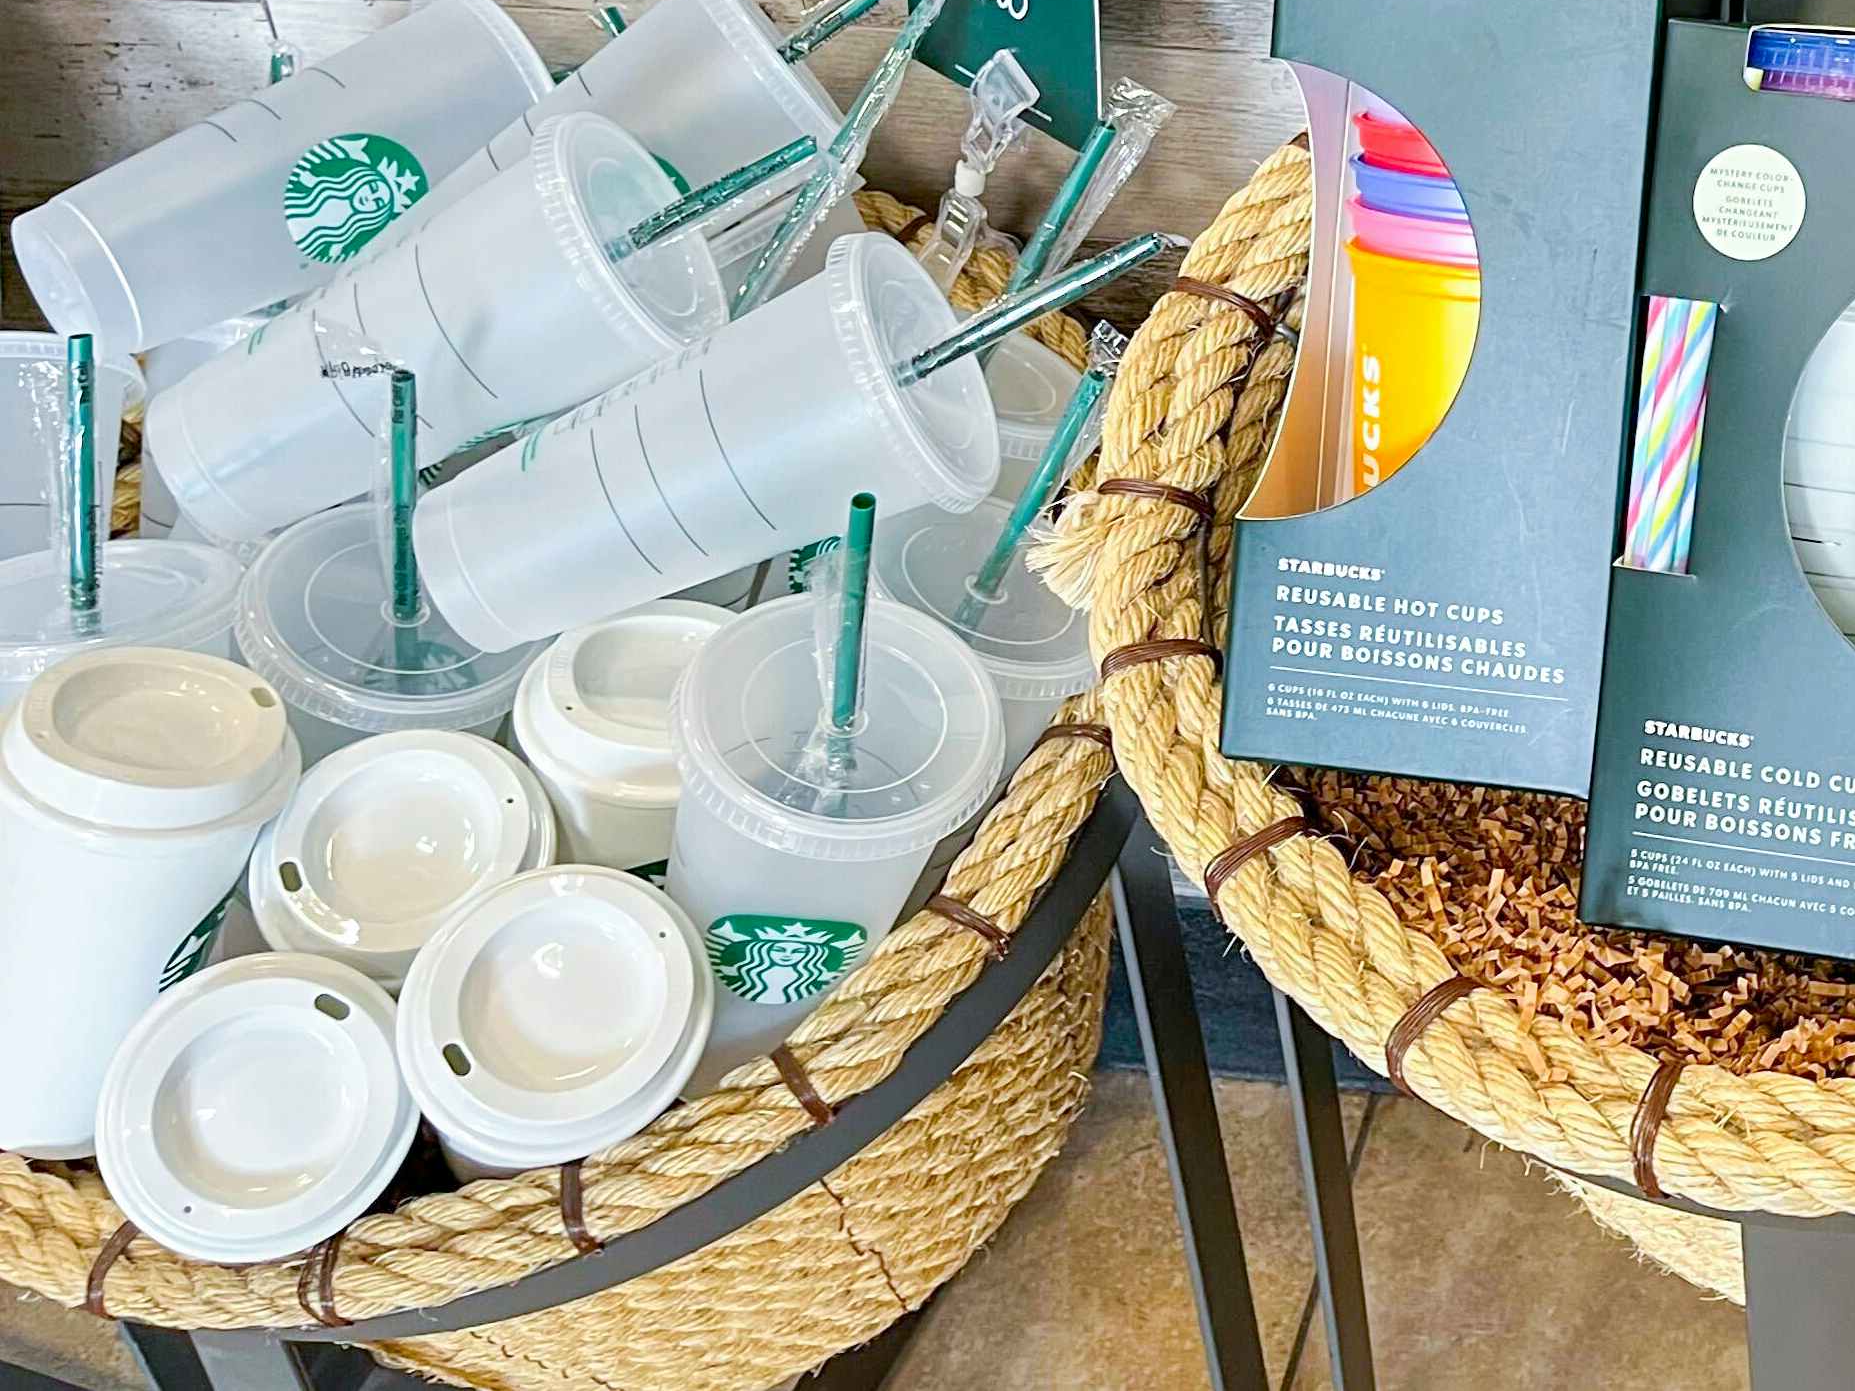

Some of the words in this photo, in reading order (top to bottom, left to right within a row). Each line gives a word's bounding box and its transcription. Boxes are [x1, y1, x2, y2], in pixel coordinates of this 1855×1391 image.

[1717, 179, 1756, 190] CHANGE
[1759, 183, 1785, 193] CUPS
[1716, 228, 1728, 237] DE
[1731, 230, 1776, 241] COULEUR
[1277, 557, 1382, 582] STARBUCKS
[1276, 584, 1387, 613] REUSABLE
[1393, 598, 1439, 619] HOT
[1446, 604, 1505, 626] CUPS
[1274, 615, 1352, 639] TASSES
[1359, 623, 1527, 659] RÉUTILISABLES
[1272, 636, 1334, 659] POUR
[1341, 645, 1453, 673] BOISSONS
[1460, 658, 1566, 684] CHAUDES
[1277, 684, 1305, 695] CUPS
[1326, 689, 1337, 699] FL
[1340, 691, 1355, 701] OZ
[1357, 693, 1389, 706] EACH)
[1391, 697, 1419, 707] WITH
[1266, 707, 1293, 718] SANS
[1277, 697, 1312, 709] TASSES
[1314, 702, 1328, 712] DE
[1331, 705, 1350, 714] 473
[1352, 706, 1367, 716] ML
[1370, 709, 1419, 722] CHACUNE
[1422, 714, 1449, 726] AVEC
[1644, 719, 1752, 749] STARBUCKS
[1640, 747, 1753, 781] REUSABLE
[1760, 765, 1821, 790] COLD
[1636, 780, 1751, 812] GOBELETS
[1634, 802, 1697, 828] POUR
[1705, 812, 1823, 846] BOISSONS
[1629, 859, 1650, 870] BPA
[1640, 850, 1667, 863] CUPS
[1670, 855, 1689, 866] (24
[1692, 857, 1703, 868] FL
[1706, 860, 1721, 871] OZ
[1723, 862, 1756, 877] EACH)
[1759, 868, 1788, 880] WITH
[1800, 873, 1824, 885] LIDS
[1827, 878, 1850, 888] AND
[1627, 885, 1639, 896] ET
[1698, 896, 1725, 909] SANS
[1637, 876, 1690, 893] GOBELETS
[1692, 884, 1706, 896] DE
[1733, 890, 1748, 902] ML
[1751, 893, 1797, 908] CHACUN
[1799, 900, 1827, 913] AVEC
